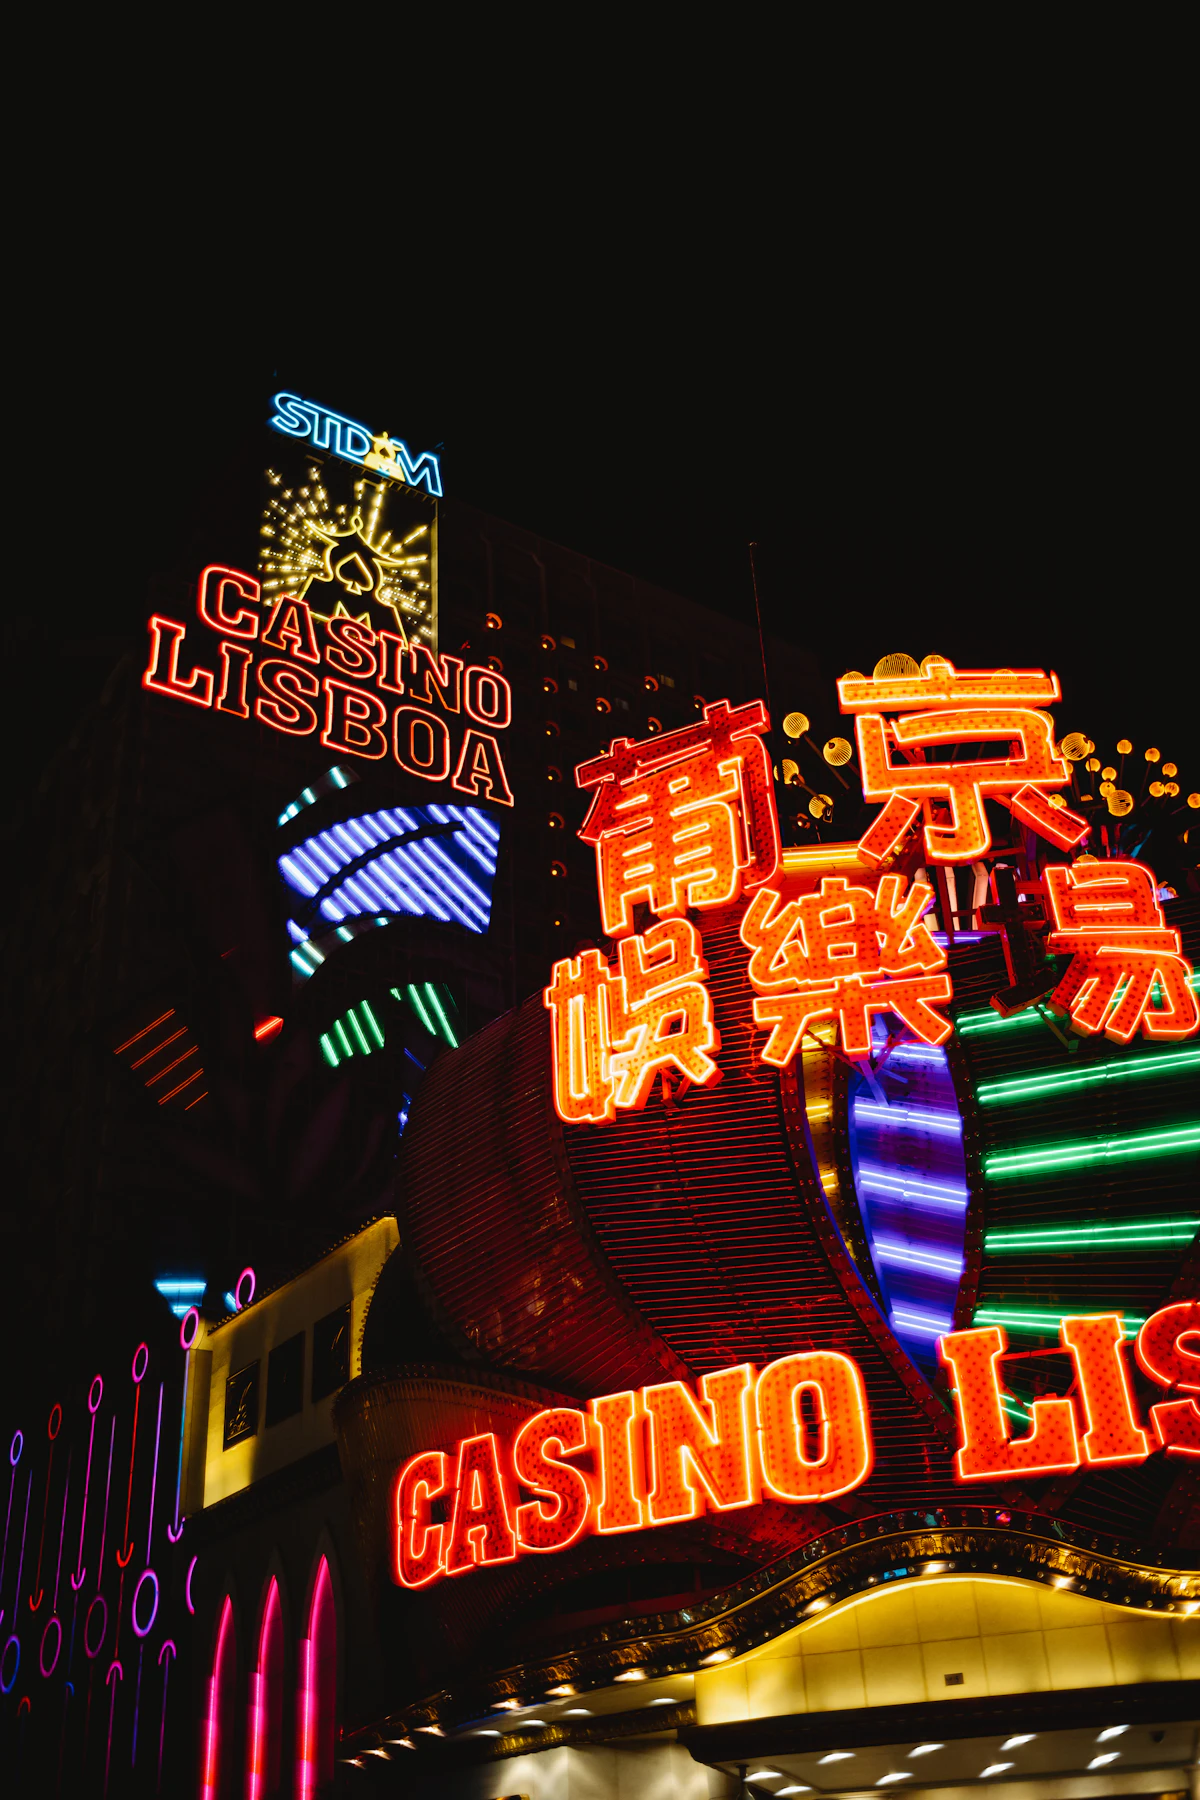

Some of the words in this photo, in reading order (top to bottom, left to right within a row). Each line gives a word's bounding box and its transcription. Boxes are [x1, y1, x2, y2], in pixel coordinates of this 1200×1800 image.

[271, 392, 443, 498] STDM
[142, 614, 515, 807] LISBOA
[200, 564, 513, 730] CASINO
[576, 655, 1091, 938] 葡京
[393, 1350, 872, 1590] CASINO
